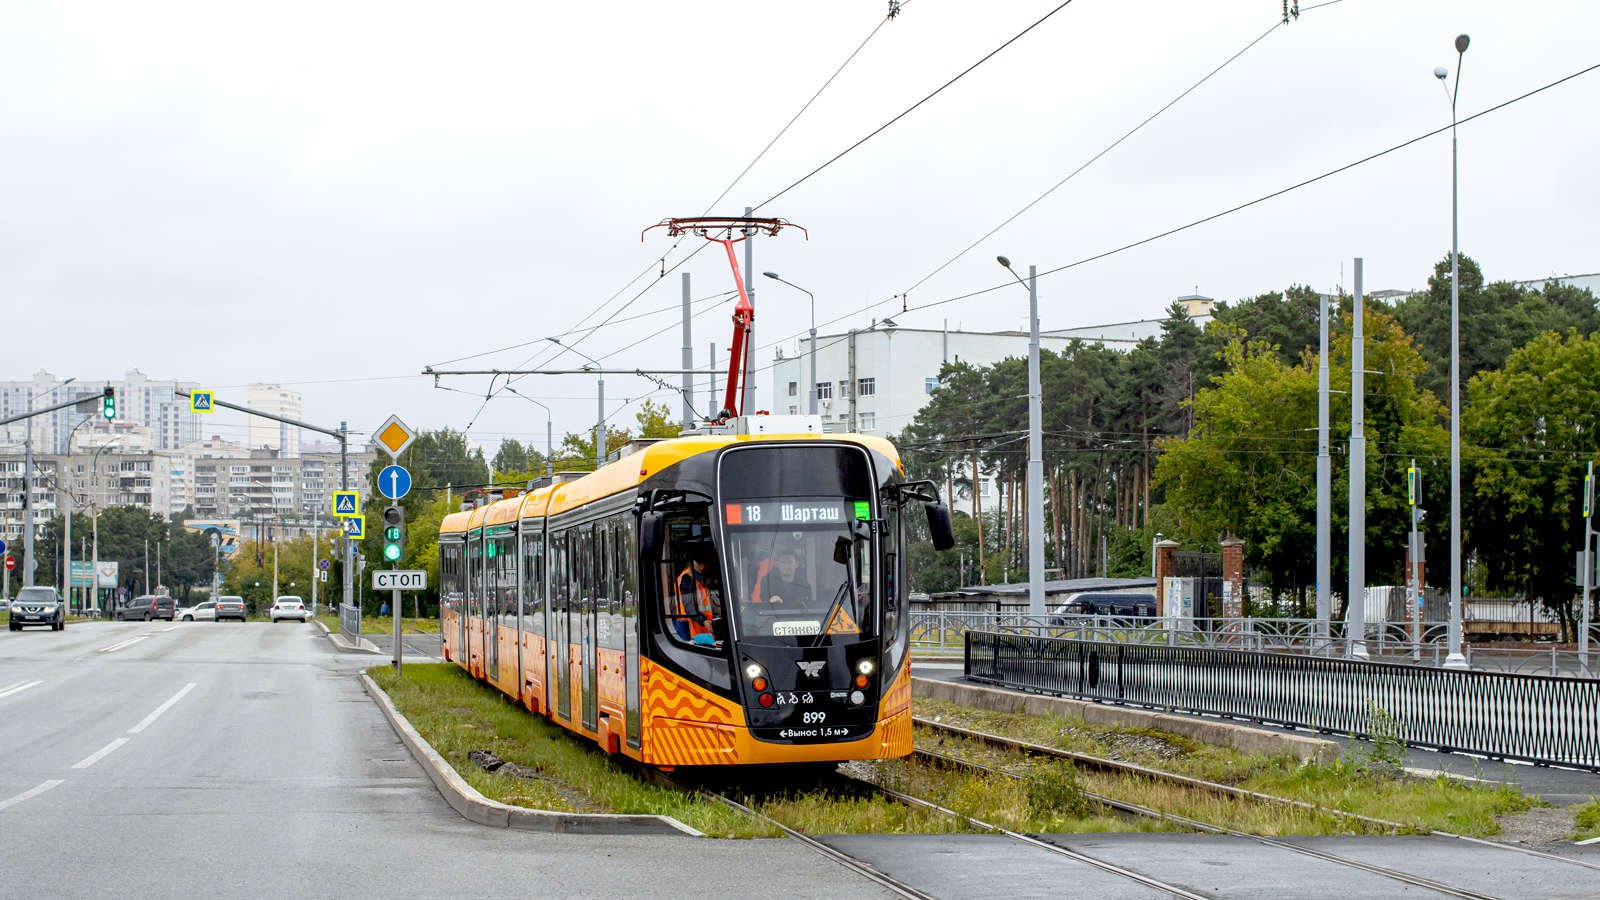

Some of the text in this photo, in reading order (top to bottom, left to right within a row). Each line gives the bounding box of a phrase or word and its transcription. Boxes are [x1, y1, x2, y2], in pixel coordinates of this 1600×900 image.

[746, 504, 839, 522] 18 Шарташ
[388, 528, 400, 539] 18
[378, 574, 421, 586] СТОП
[803, 711, 826, 724] 899
[788, 729, 818, 737] Вынос
[820, 727, 832, 737] 1,5
